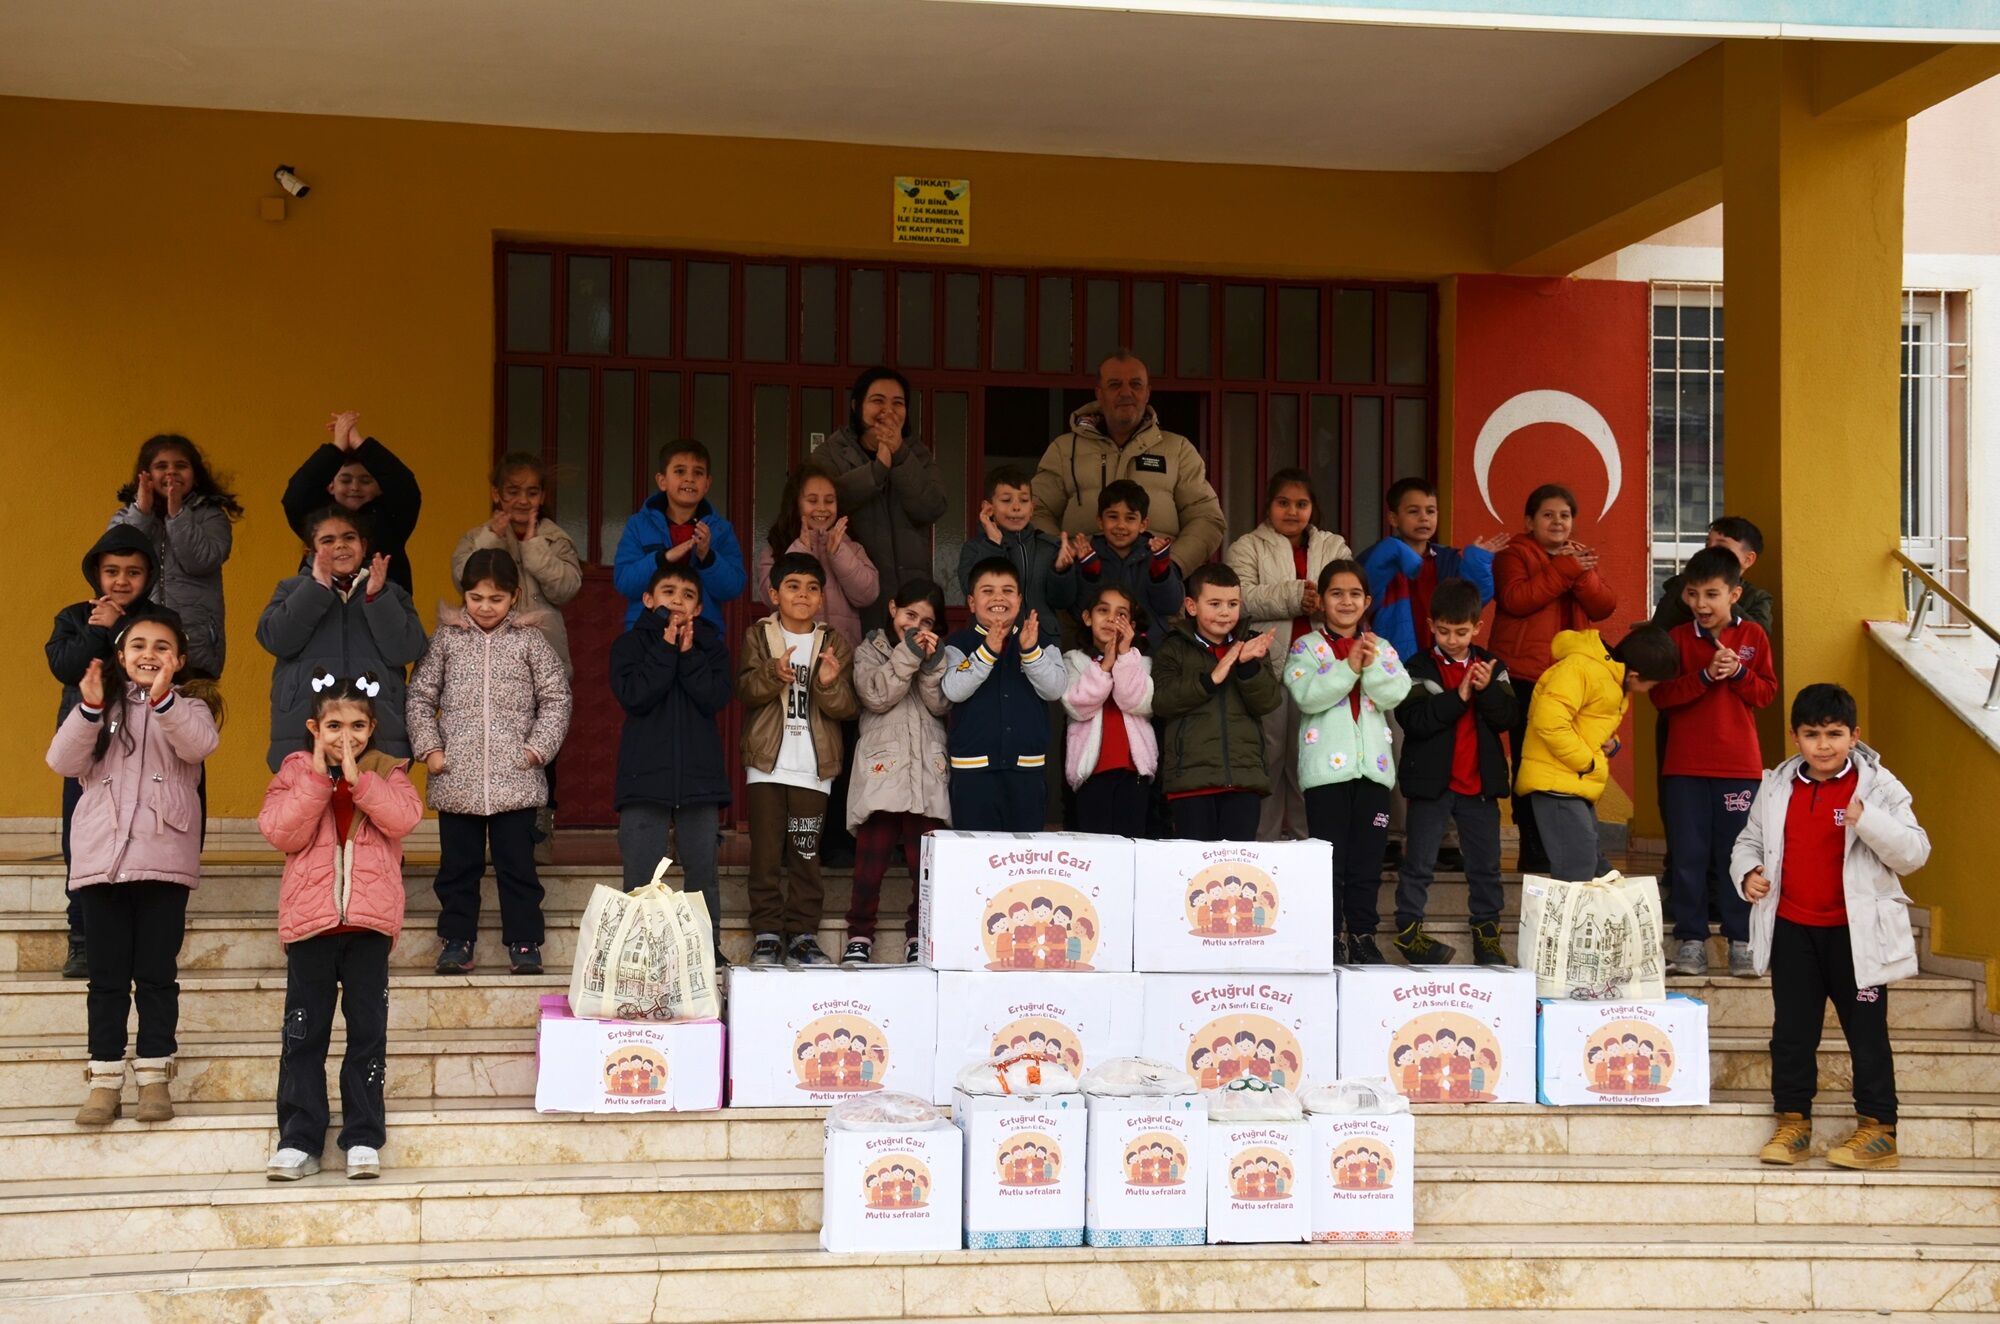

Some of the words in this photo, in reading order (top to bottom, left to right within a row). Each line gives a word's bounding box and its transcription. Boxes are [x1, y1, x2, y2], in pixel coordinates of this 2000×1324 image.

[928, 198, 947, 206] BİNA
[925, 208, 959, 216] KAMERA
[909, 225, 932, 233] KAYIT
[935, 227, 964, 235] ALTINA
[1833, 808, 1848, 826] E
[1202, 848, 1238, 860] Ertuğrul
[1240, 848, 1259, 860] Gazi
[989, 849, 1052, 869] Ertuğrul
[1057, 851, 1092, 872] Gazi
[1026, 867, 1046, 875] Sınıfı
[1048, 867, 1057, 876] El
[1058, 869, 1072, 879] Ele
[1229, 938, 1265, 946] sofralara
[1191, 984, 1254, 1005] Ertuğrul
[1259, 985, 1293, 1005] Gazi
[1393, 981, 1454, 1002] Ertuğrul
[1458, 983, 1492, 1003] Gazi
[812, 1000, 850, 1011] Ertuğrul
[851, 1000, 871, 1012] Gazi
[1008, 1002, 1045, 1014] Ertuğrul
[1046, 1003, 1066, 1015] Gazi
[1260, 1003, 1274, 1011] Ele
[1450, 999, 1459, 1007] El
[1460, 1001, 1473, 1010] Ele
[1600, 1005, 1635, 1017] Ertuğrul
[1636, 1006, 1655, 1017] Gazi
[607, 1029, 643, 1041] Ertuğrul
[645, 1030, 665, 1041] Gazi
[631, 1097, 667, 1105] sofralara
[809, 1092, 834, 1100] Mutlu
[1599, 1095, 1623, 1103] Mutlu
[1625, 1095, 1660, 1103] sofralara
[999, 1114, 1036, 1127] Ertuğrul
[1037, 1115, 1057, 1126] Gazi
[1126, 1115, 1163, 1127] Ertuğrul
[1164, 1116, 1184, 1127] Gazi
[1333, 1120, 1368, 1132] Ertuğrul
[1370, 1121, 1389, 1132] Gazi
[1230, 1130, 1267, 1142] Ertuğrul
[1268, 1130, 1289, 1141] Gazi
[866, 1136, 904, 1149] Ertuğrul
[905, 1137, 926, 1149] Gazi
[999, 1188, 1023, 1196] Mutlu
[1025, 1187, 1061, 1195] sofralara
[1125, 1188, 1149, 1196] Mutlu
[1151, 1187, 1186, 1195] sofralara
[1333, 1192, 1357, 1200] Mutlu
[1359, 1192, 1394, 1200] sofralara
[1231, 1202, 1256, 1210] Mutlu
[865, 1211, 891, 1219] Mutlu
[892, 1210, 930, 1219] sofralara
